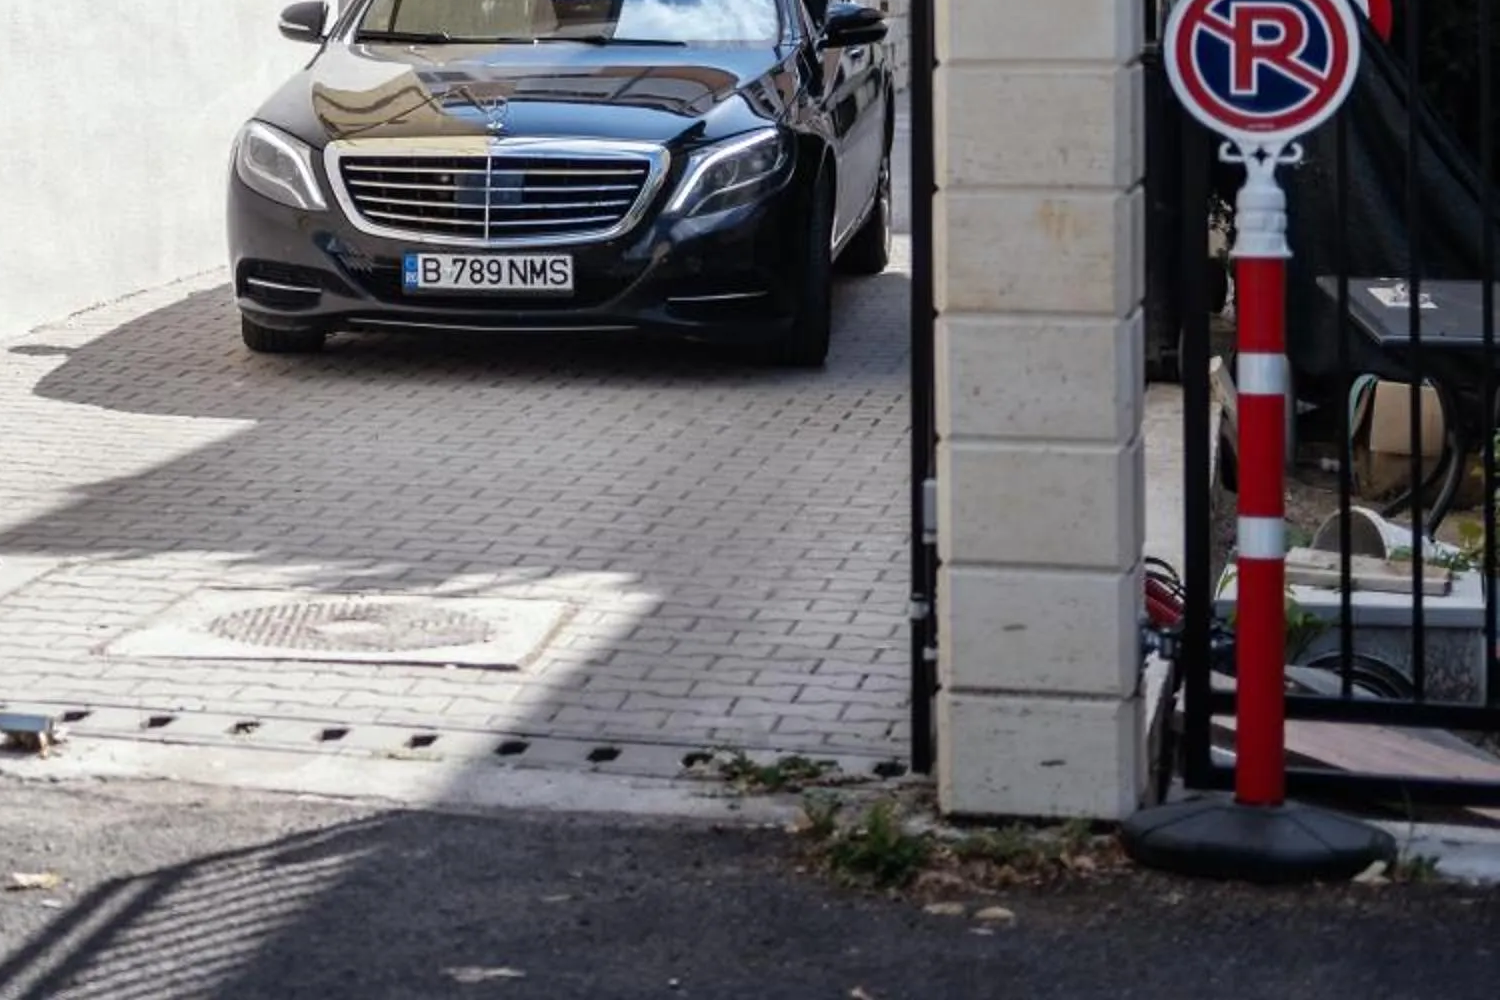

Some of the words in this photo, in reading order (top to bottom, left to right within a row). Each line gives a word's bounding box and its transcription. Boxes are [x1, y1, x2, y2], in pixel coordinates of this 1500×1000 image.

[422, 257, 442, 284] B
[451, 258, 502, 285] 789
[508, 259, 569, 286] NMS
